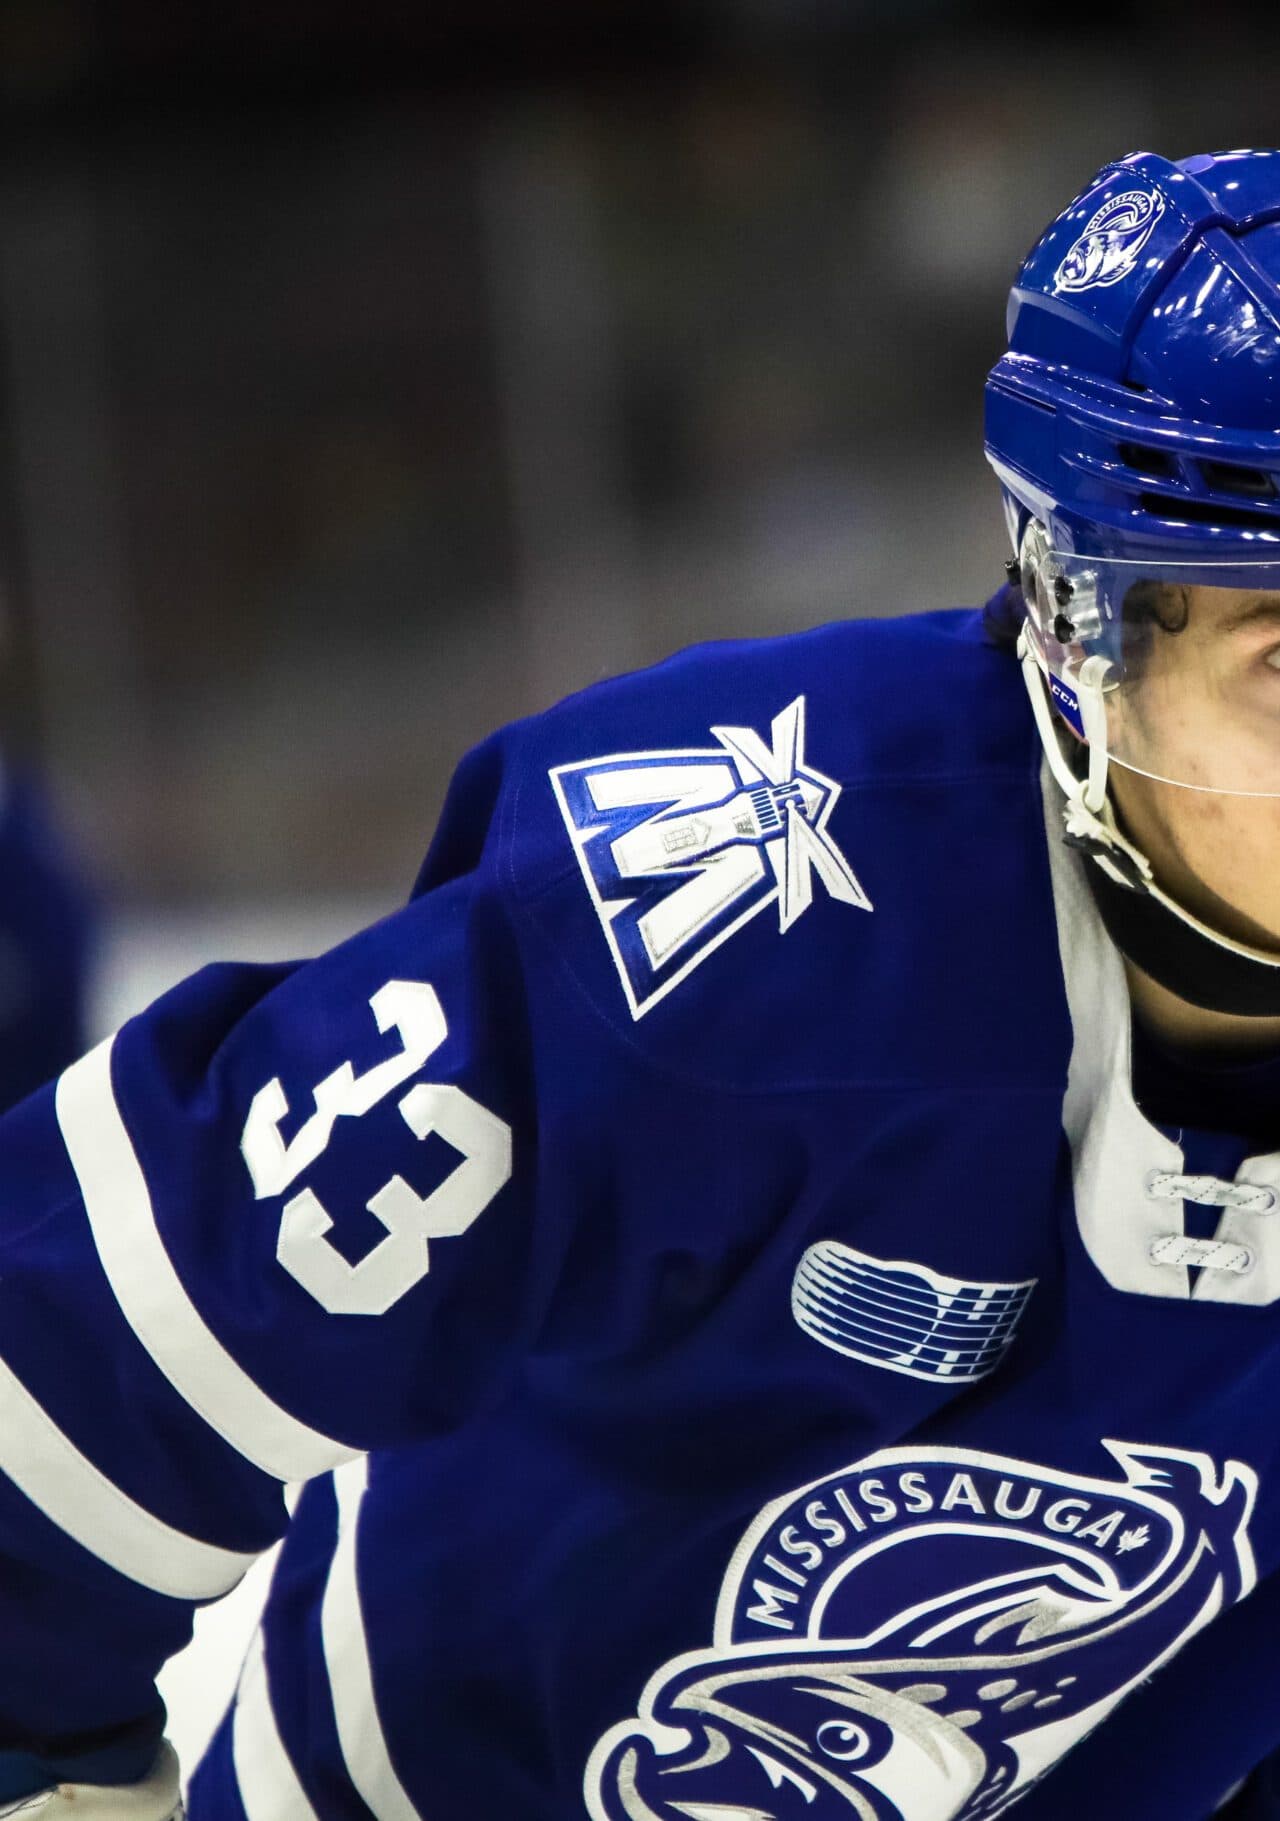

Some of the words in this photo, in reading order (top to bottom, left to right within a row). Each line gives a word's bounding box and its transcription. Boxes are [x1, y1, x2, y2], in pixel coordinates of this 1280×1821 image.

[1051, 683, 1078, 711] CCM
[240, 980, 512, 1316] 33
[745, 1471, 1125, 1630] MISSISSAUGA
